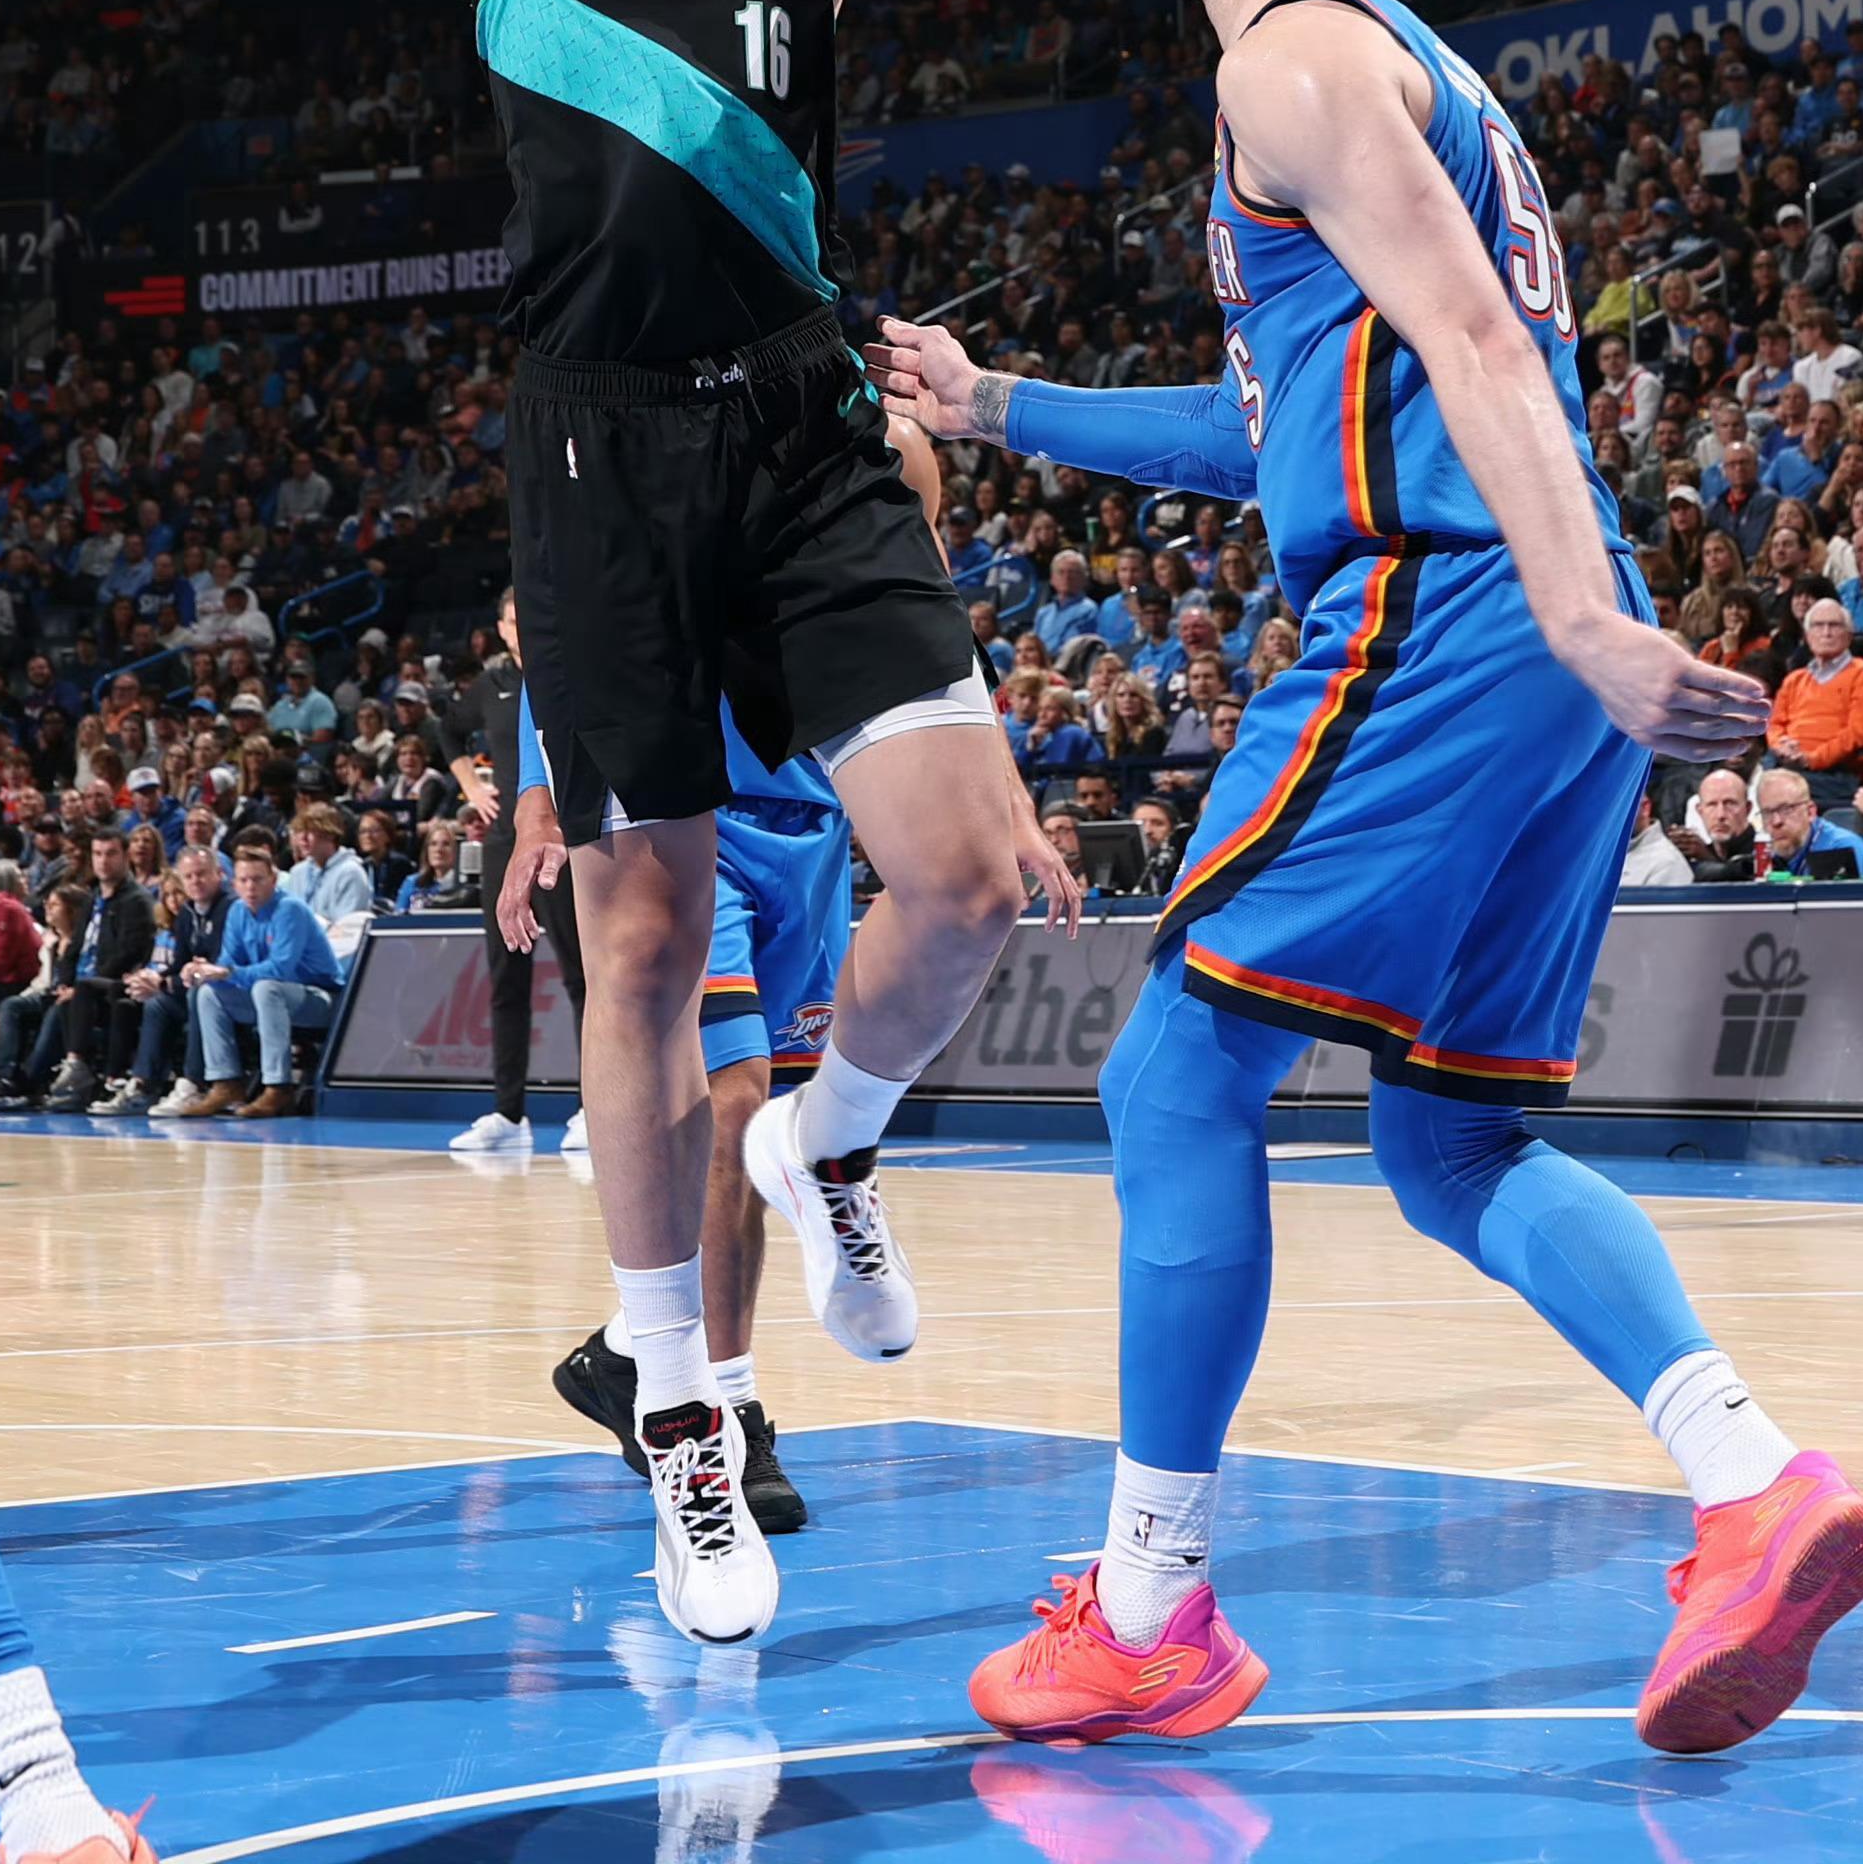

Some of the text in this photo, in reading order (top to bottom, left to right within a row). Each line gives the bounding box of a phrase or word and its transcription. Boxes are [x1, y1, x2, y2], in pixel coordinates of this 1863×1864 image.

[735, 0, 792, 100] 16
[195, 218, 261, 256] 113
[200, 246, 512, 313] COMMITMENT RUNS DEEP
[1483, 119, 1578, 343] 55
[979, 954, 1117, 1067] the
